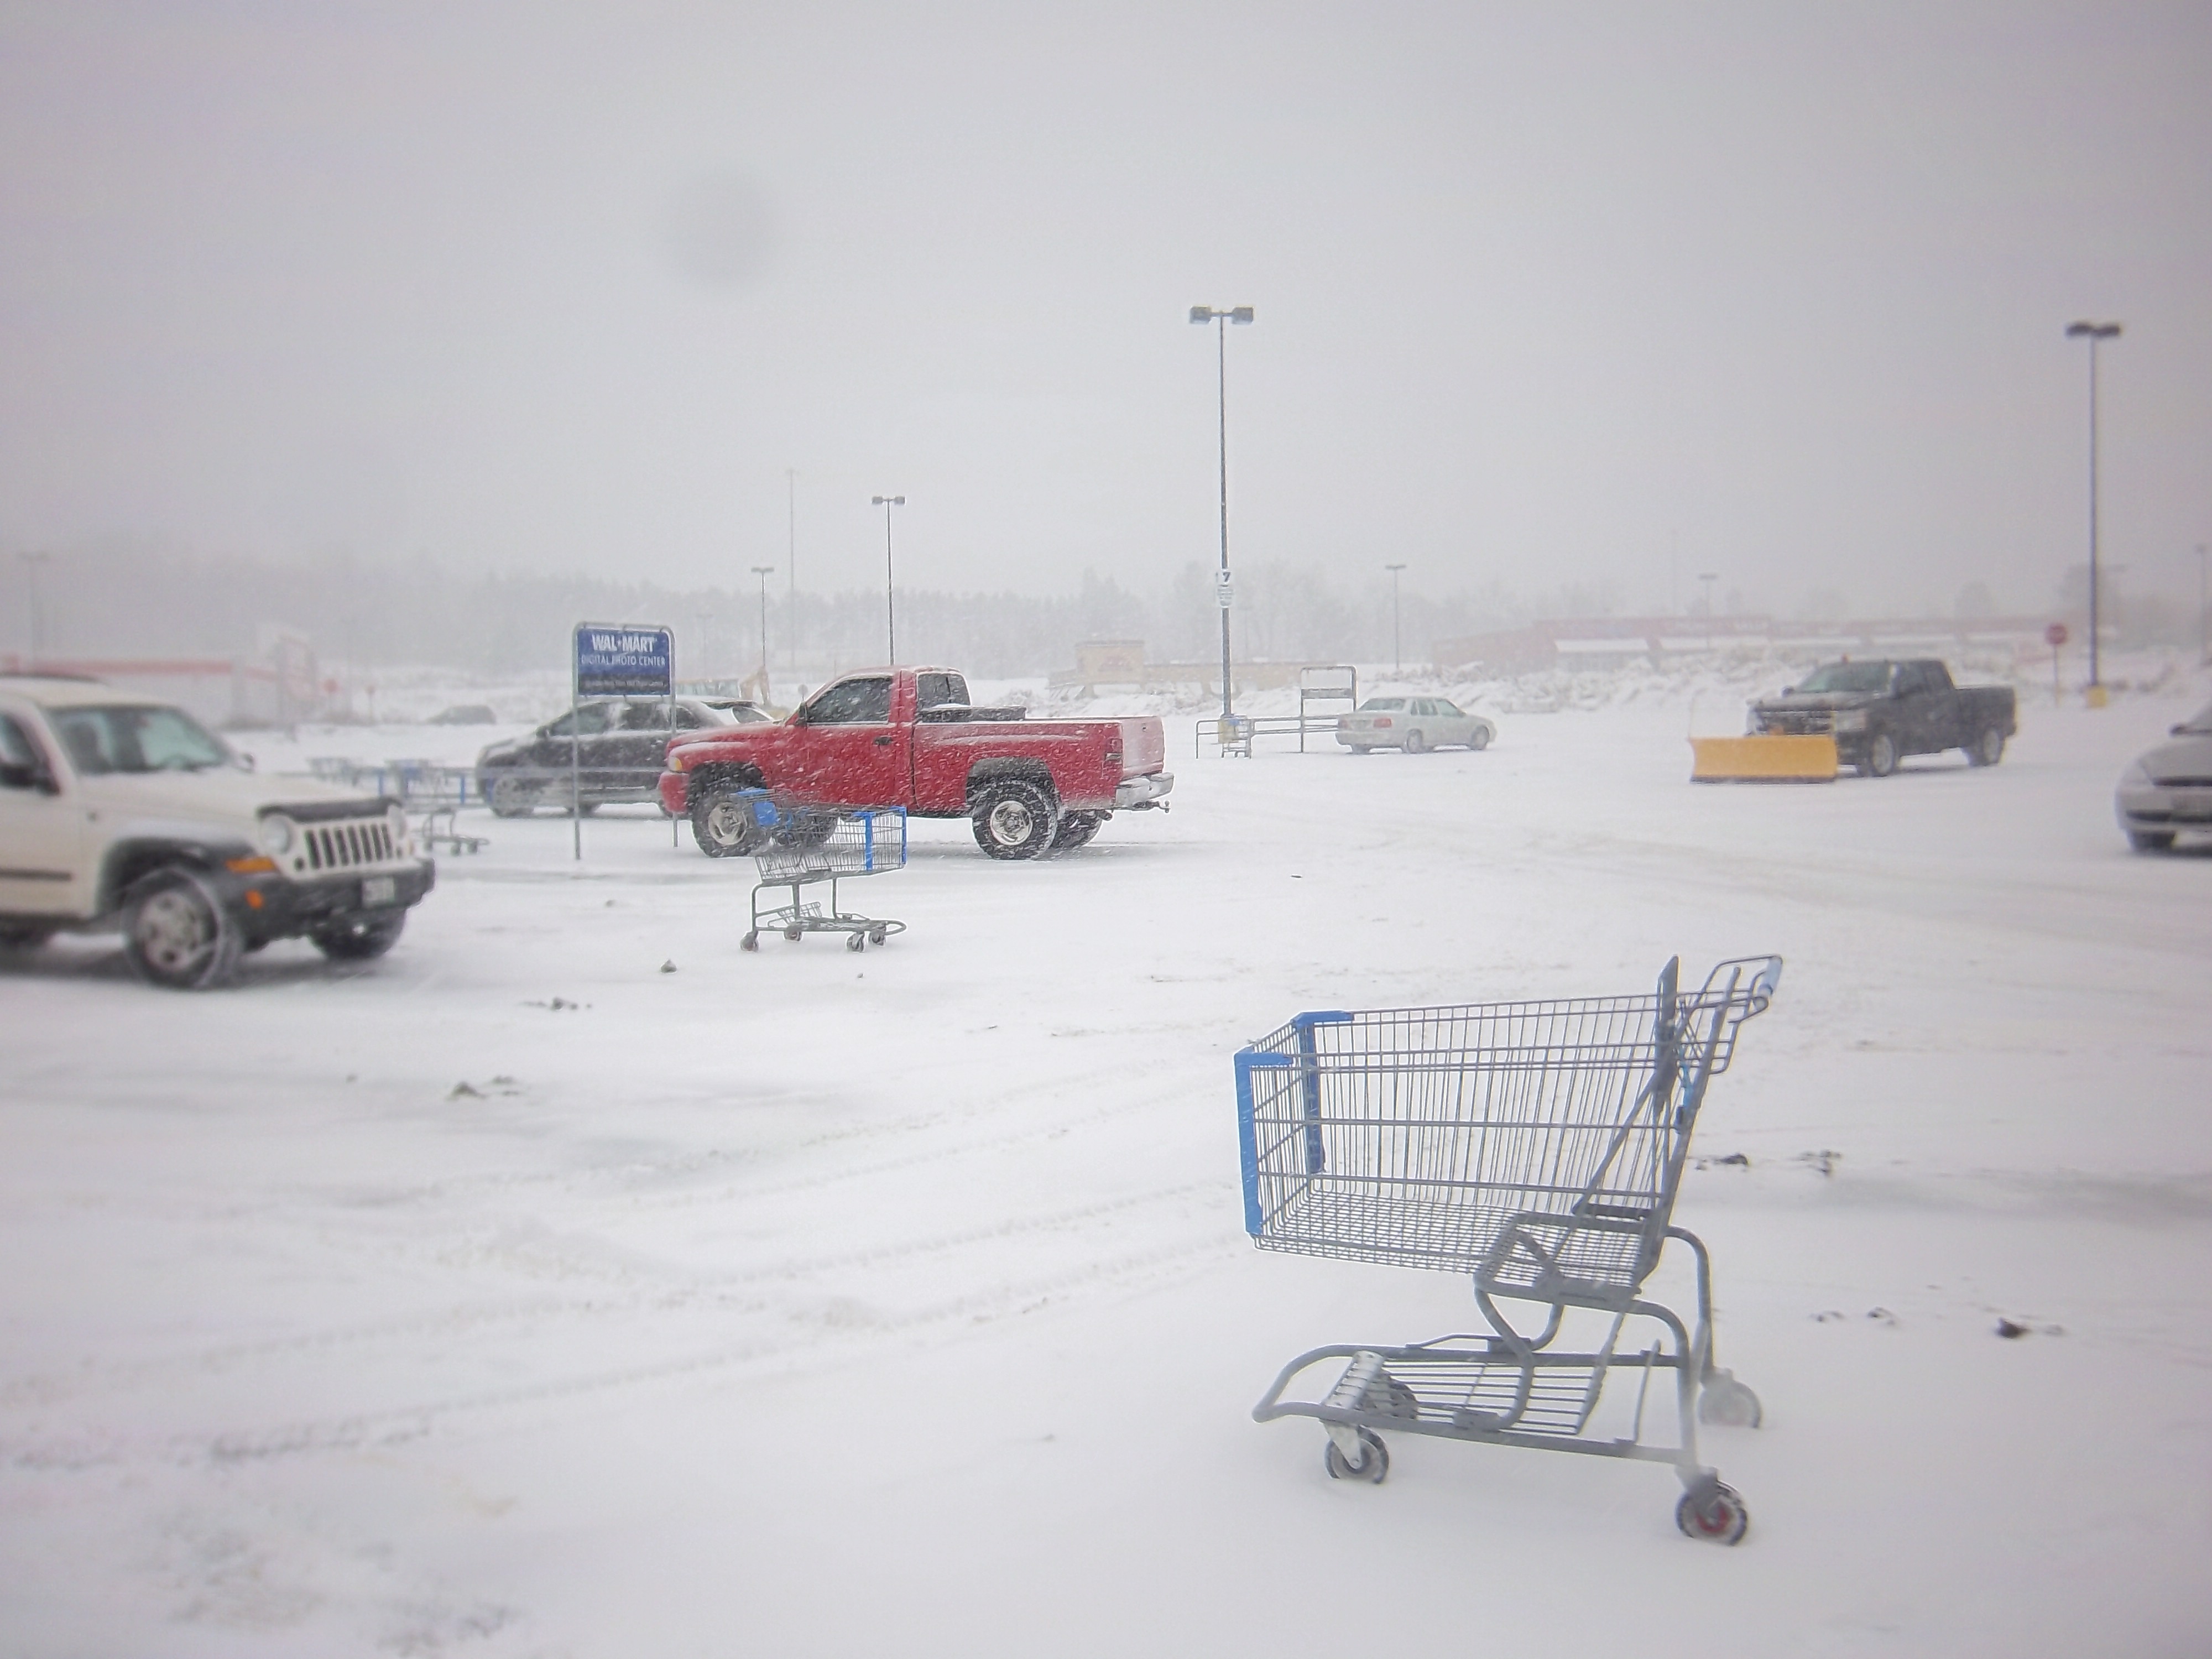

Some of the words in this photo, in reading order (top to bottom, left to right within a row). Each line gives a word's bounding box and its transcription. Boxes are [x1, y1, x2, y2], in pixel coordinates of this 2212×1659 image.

[1223, 571, 1231, 582] 7
[581, 654, 609, 665] DGITAL
[639, 655, 666, 667] CENTER
